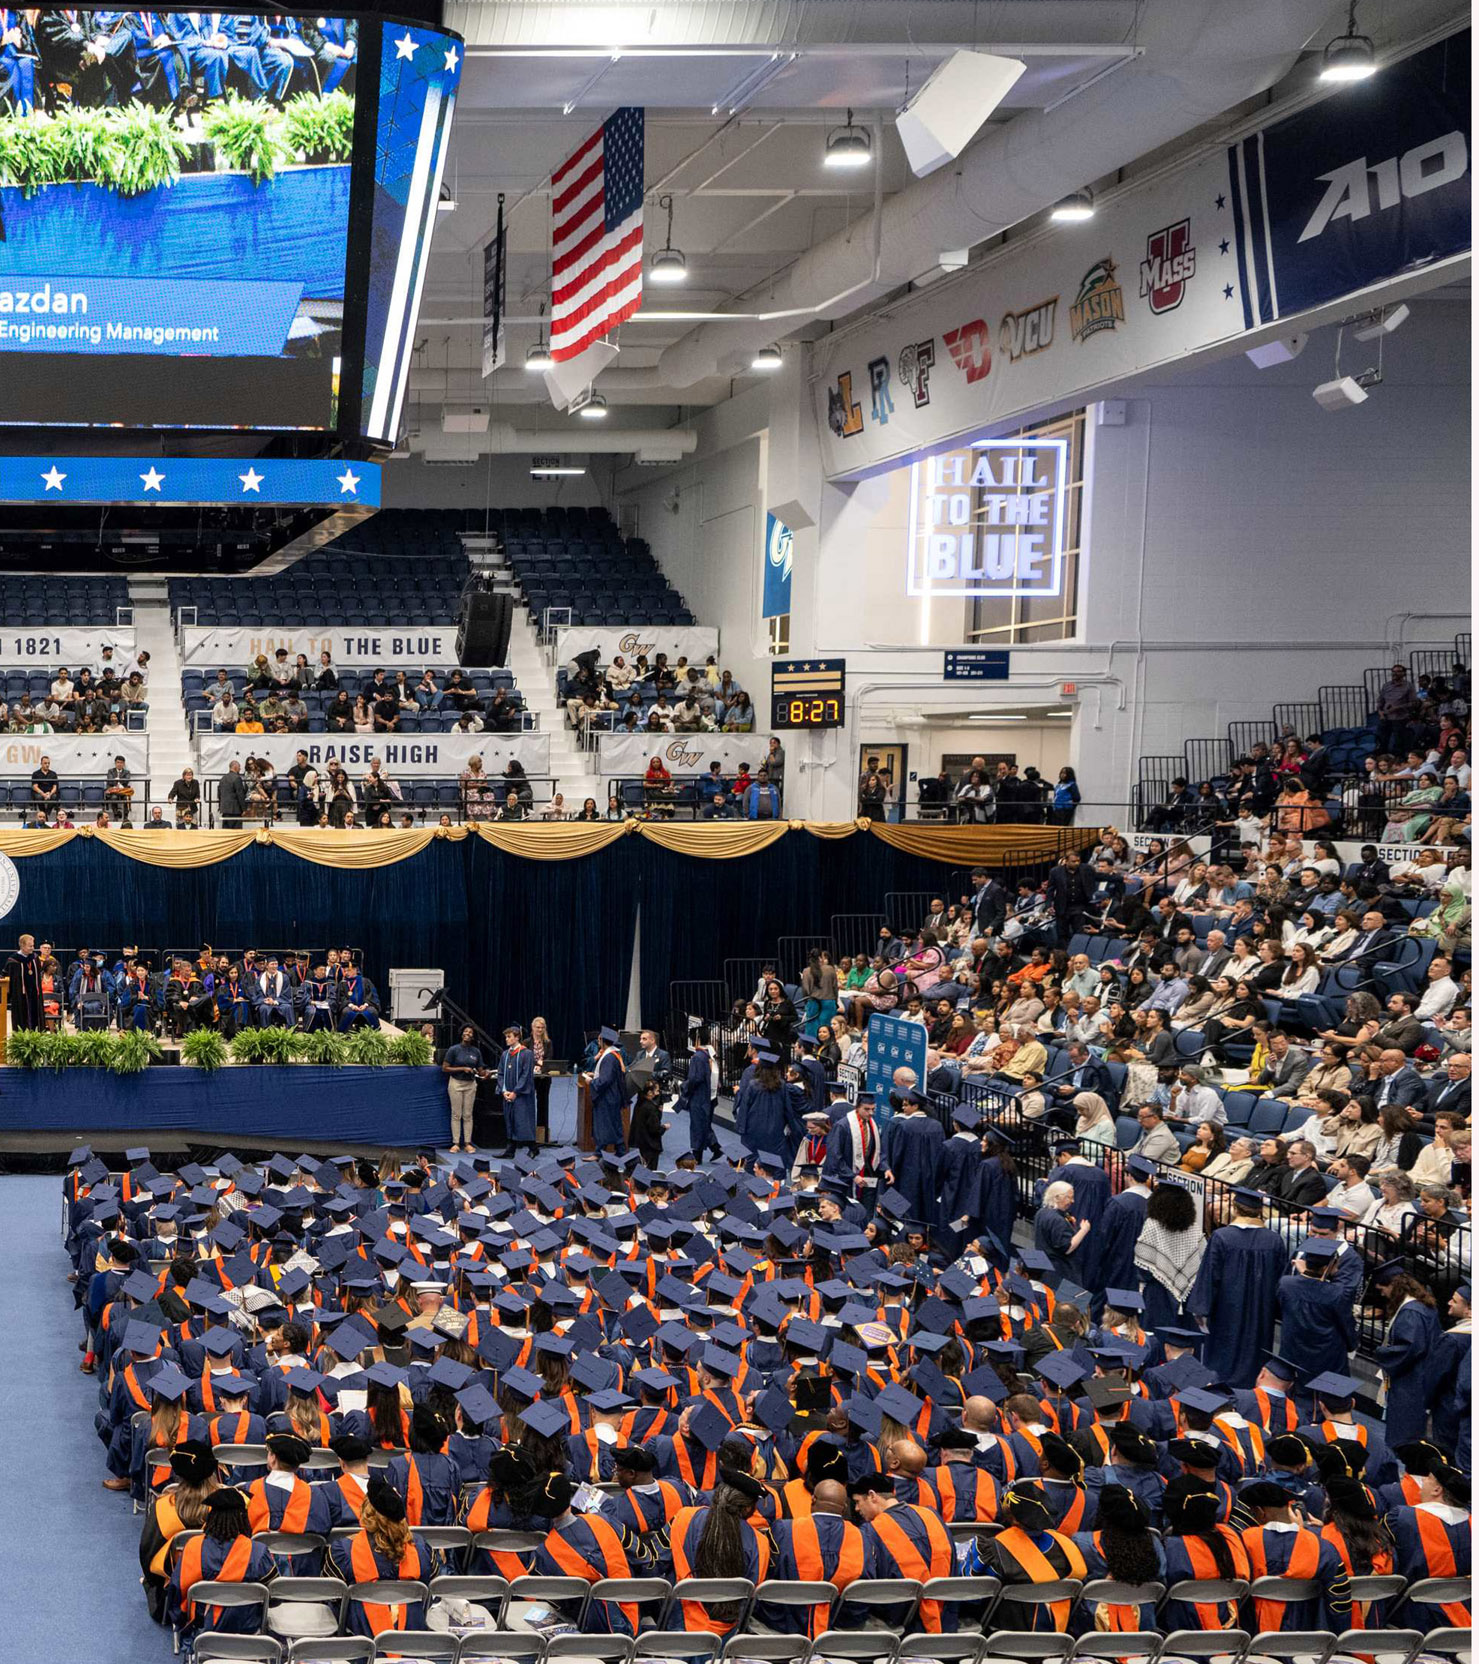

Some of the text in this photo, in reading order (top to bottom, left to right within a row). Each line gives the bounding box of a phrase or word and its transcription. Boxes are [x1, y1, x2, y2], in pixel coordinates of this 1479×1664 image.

[1296, 129, 1468, 244] A10
[106, 322, 219, 345] Management
[934, 456, 1048, 487] HAIL
[930, 494, 1049, 525] TO THE
[928, 534, 1044, 579] BLUE
[14, 637, 61, 655] 1821
[308, 638, 333, 655] TO
[344, 638, 381, 655] THE
[392, 637, 442, 655] BLUE
[619, 634, 655, 658] GW
[790, 700, 838, 723] 8:27
[7, 745, 42, 764] GW
[309, 745, 438, 764] RAISE HIGH
[666, 741, 704, 767] GW
[1378, 848, 1421, 862] SECTIO
